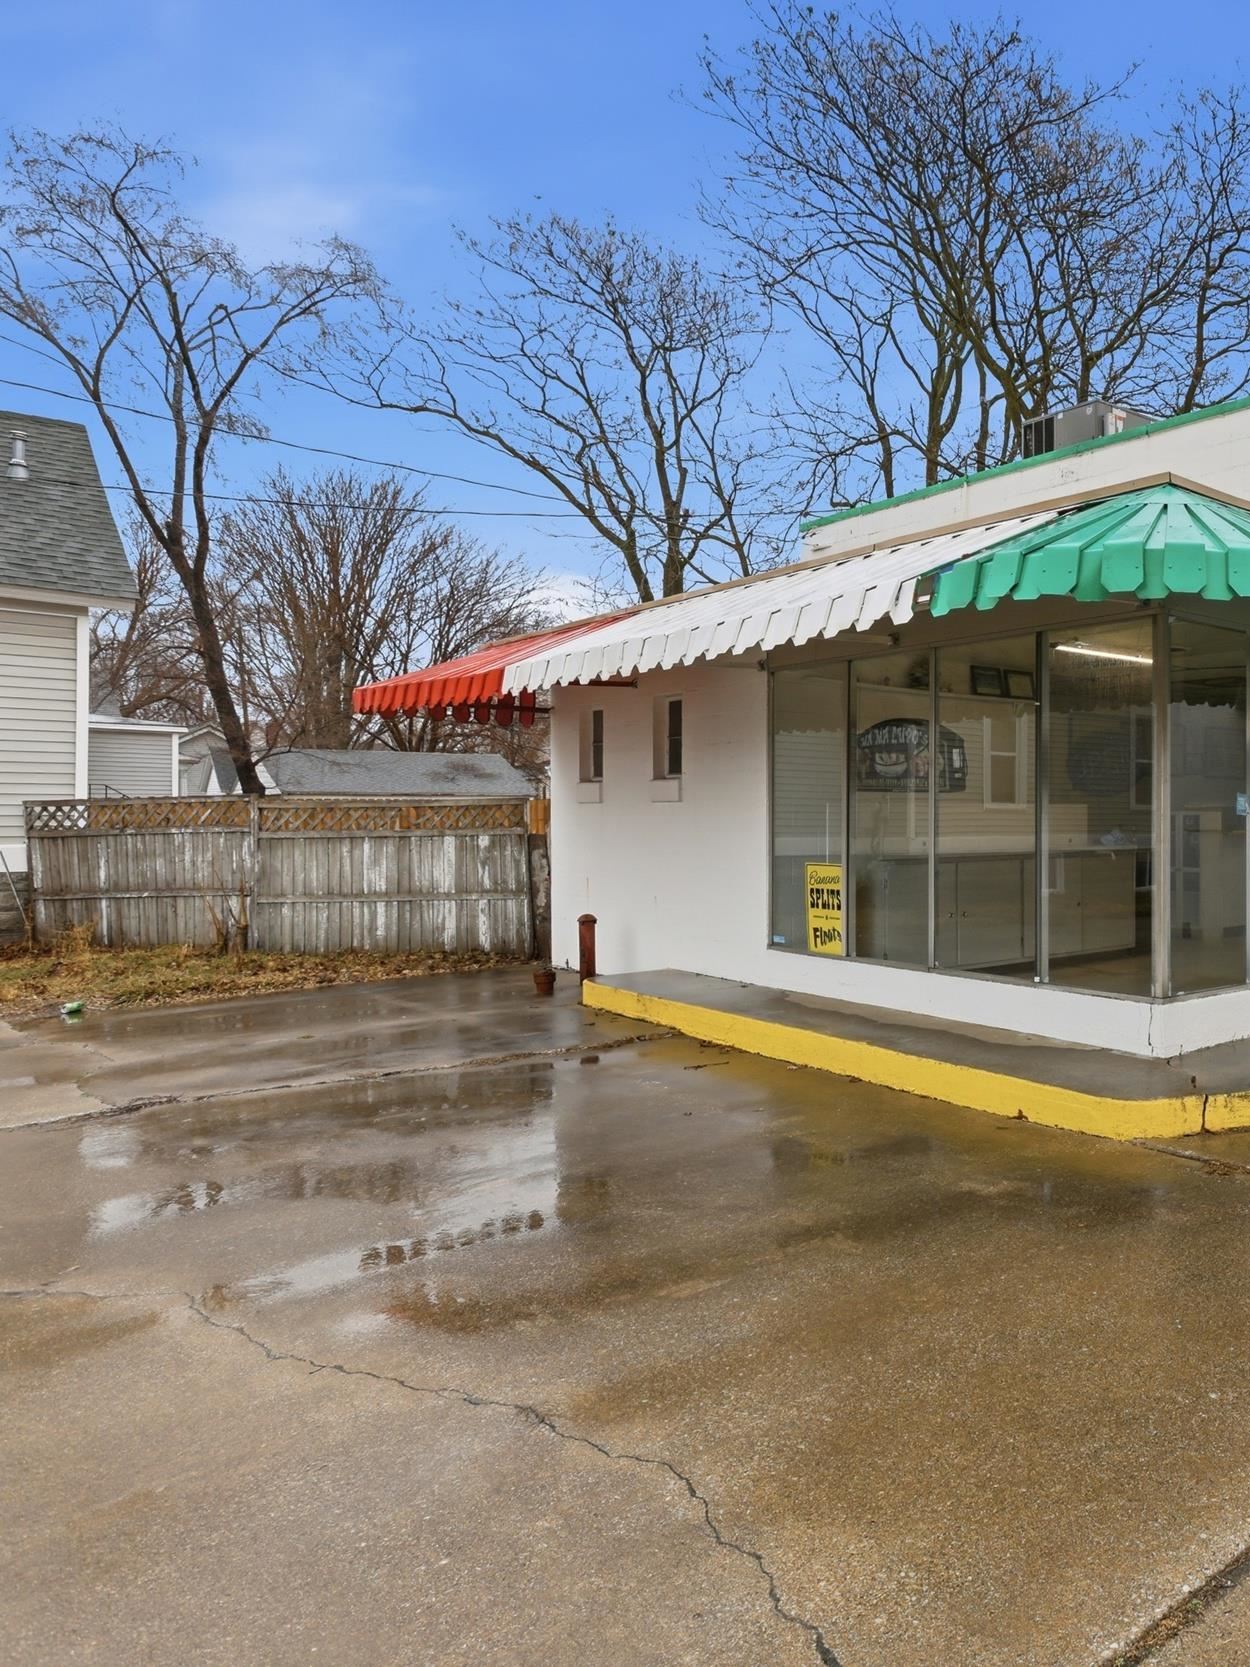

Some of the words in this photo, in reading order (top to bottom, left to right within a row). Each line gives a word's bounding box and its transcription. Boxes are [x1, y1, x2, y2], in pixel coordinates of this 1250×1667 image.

[809, 870, 840, 886] Banana
[810, 887, 841, 911] SPLITS
[813, 926, 842, 949] Floats
